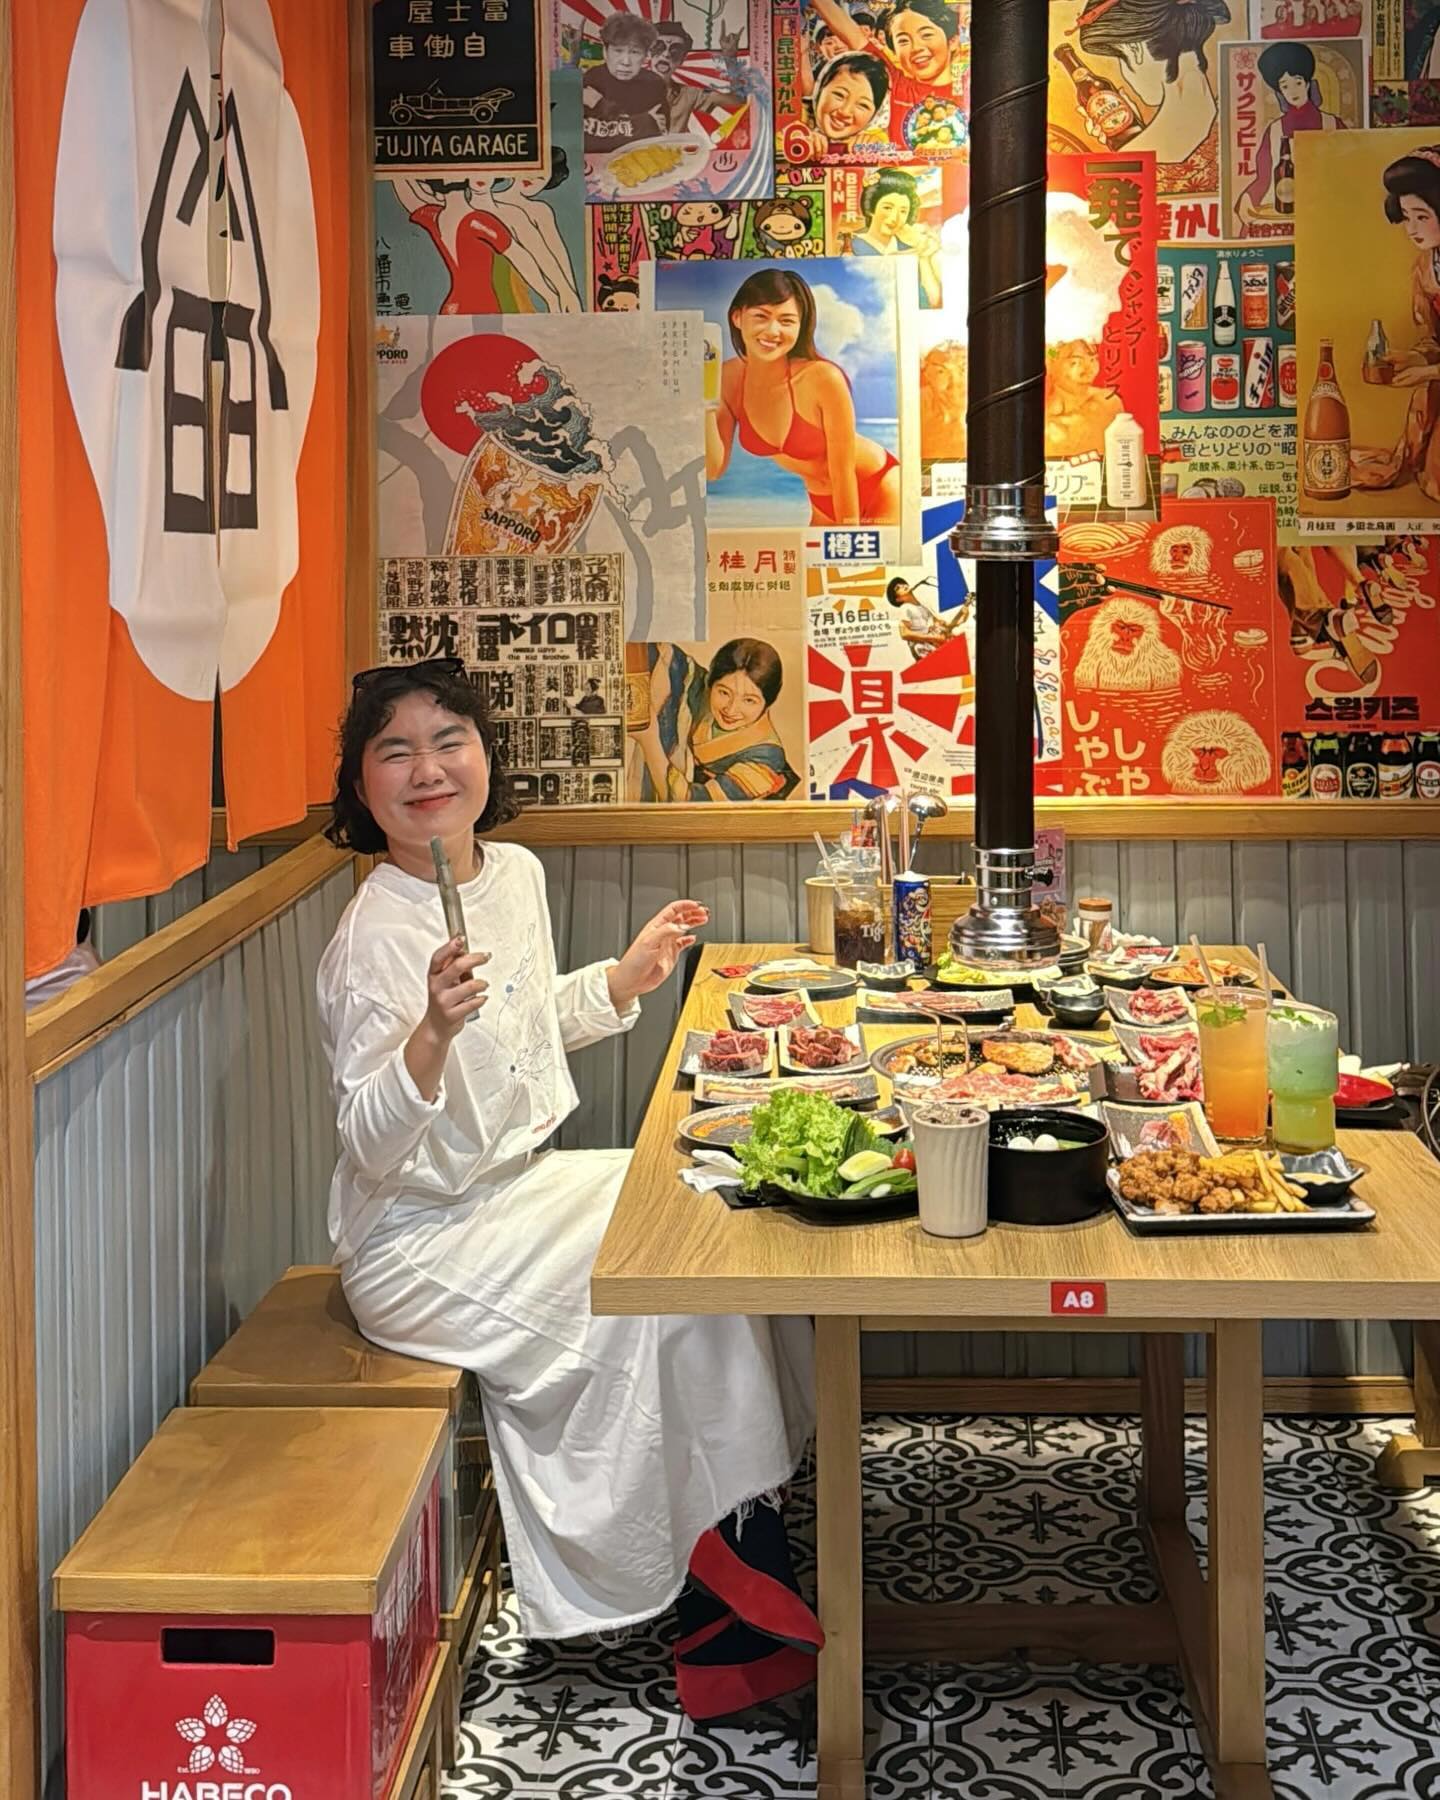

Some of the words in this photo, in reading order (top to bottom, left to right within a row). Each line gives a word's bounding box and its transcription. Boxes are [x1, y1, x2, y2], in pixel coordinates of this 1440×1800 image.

[375, 134, 444, 157] FUJIYA
[449, 133, 529, 157] GARAGE
[480, 507, 542, 544] SAPPORO
[1063, 1290, 1094, 1308] A8
[141, 1780, 292, 1800] HABECO
